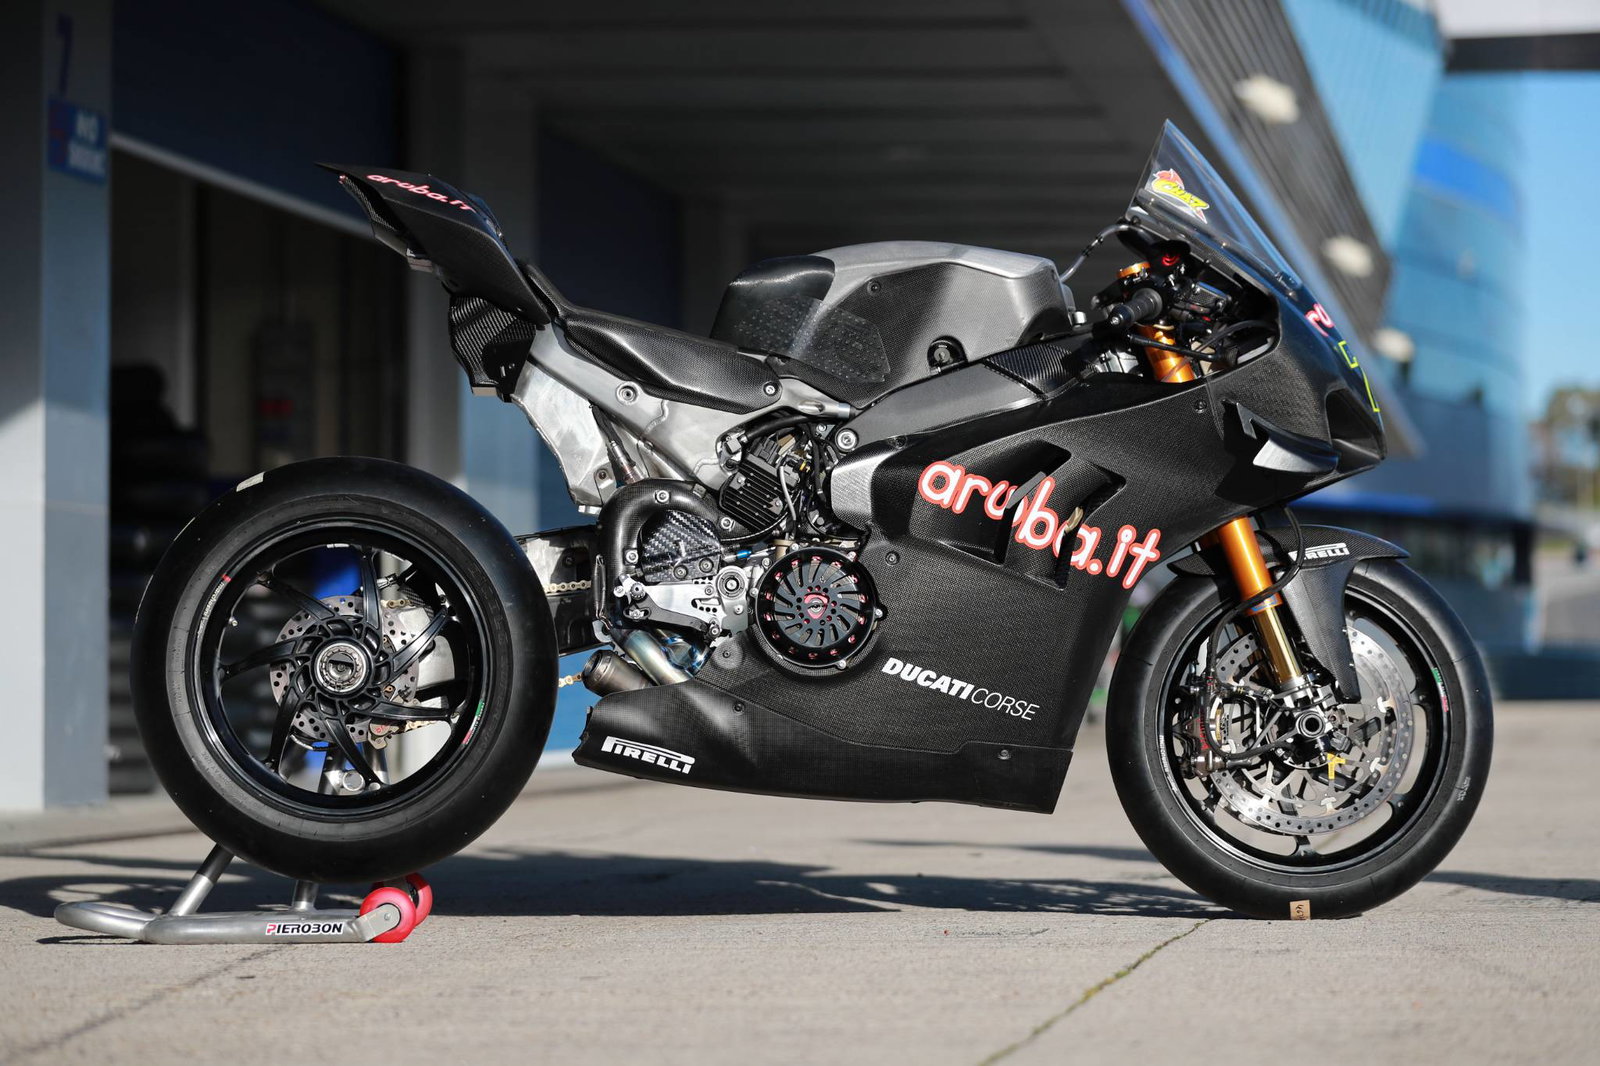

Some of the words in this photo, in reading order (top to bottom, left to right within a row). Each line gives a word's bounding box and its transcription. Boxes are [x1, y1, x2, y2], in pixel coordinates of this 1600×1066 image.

[366, 174, 477, 213] aruba.it
[918, 460, 1161, 589] aruba.it
[1288, 542, 1350, 561] PRELLI
[881, 657, 975, 700] DUCATI
[971, 688, 1040, 721] CORSE
[601, 735, 696, 774] PIRELLI
[266, 923, 343, 935] PIEROBON
